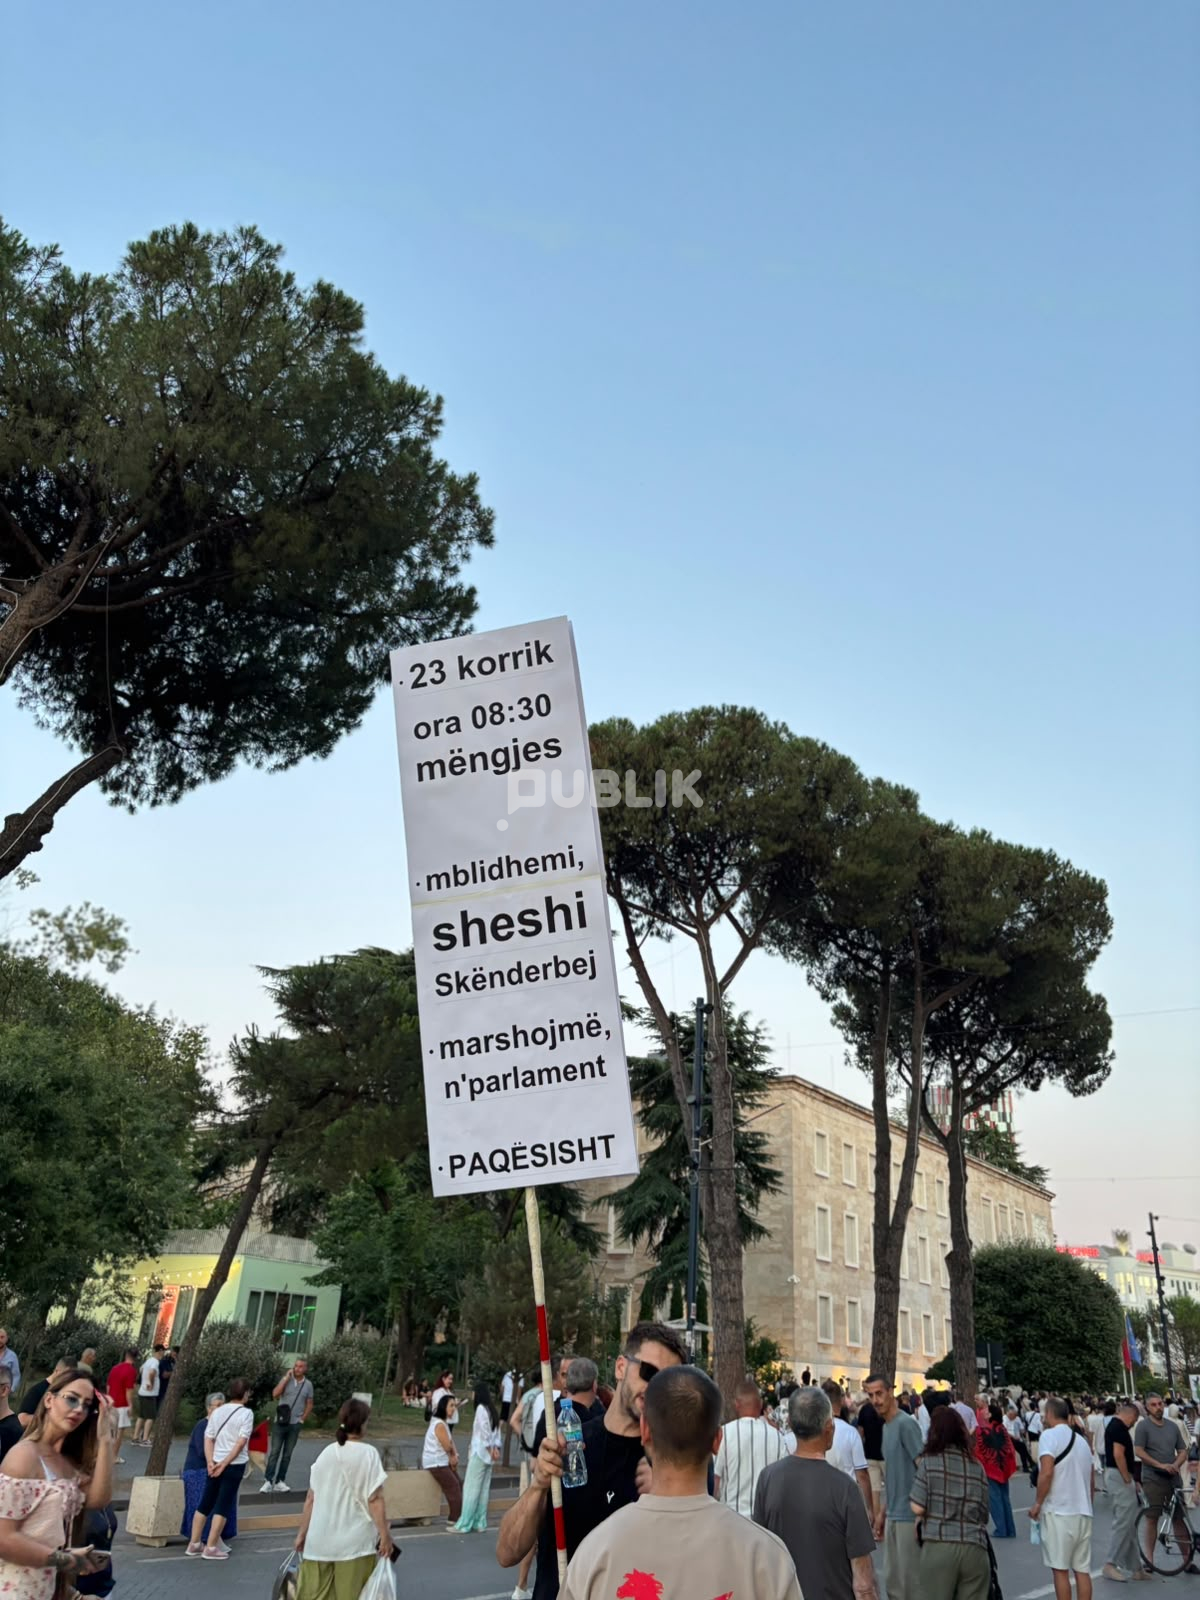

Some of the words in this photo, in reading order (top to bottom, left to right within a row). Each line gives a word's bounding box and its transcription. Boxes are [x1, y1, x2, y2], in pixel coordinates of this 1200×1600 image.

[410, 659, 447, 690] 23
[457, 640, 554, 680] korrik
[414, 716, 462, 740] ora
[471, 693, 552, 730] 08:30
[416, 737, 562, 782] mëngjes
[426, 845, 584, 892] mblidhemi,
[433, 891, 588, 952] sheshi
[435, 950, 597, 997] Skënderbej
[440, 1012, 611, 1060] marshojmë,
[444, 1055, 607, 1102] n'parlament
[449, 1134, 616, 1179] PAQËSISHT
